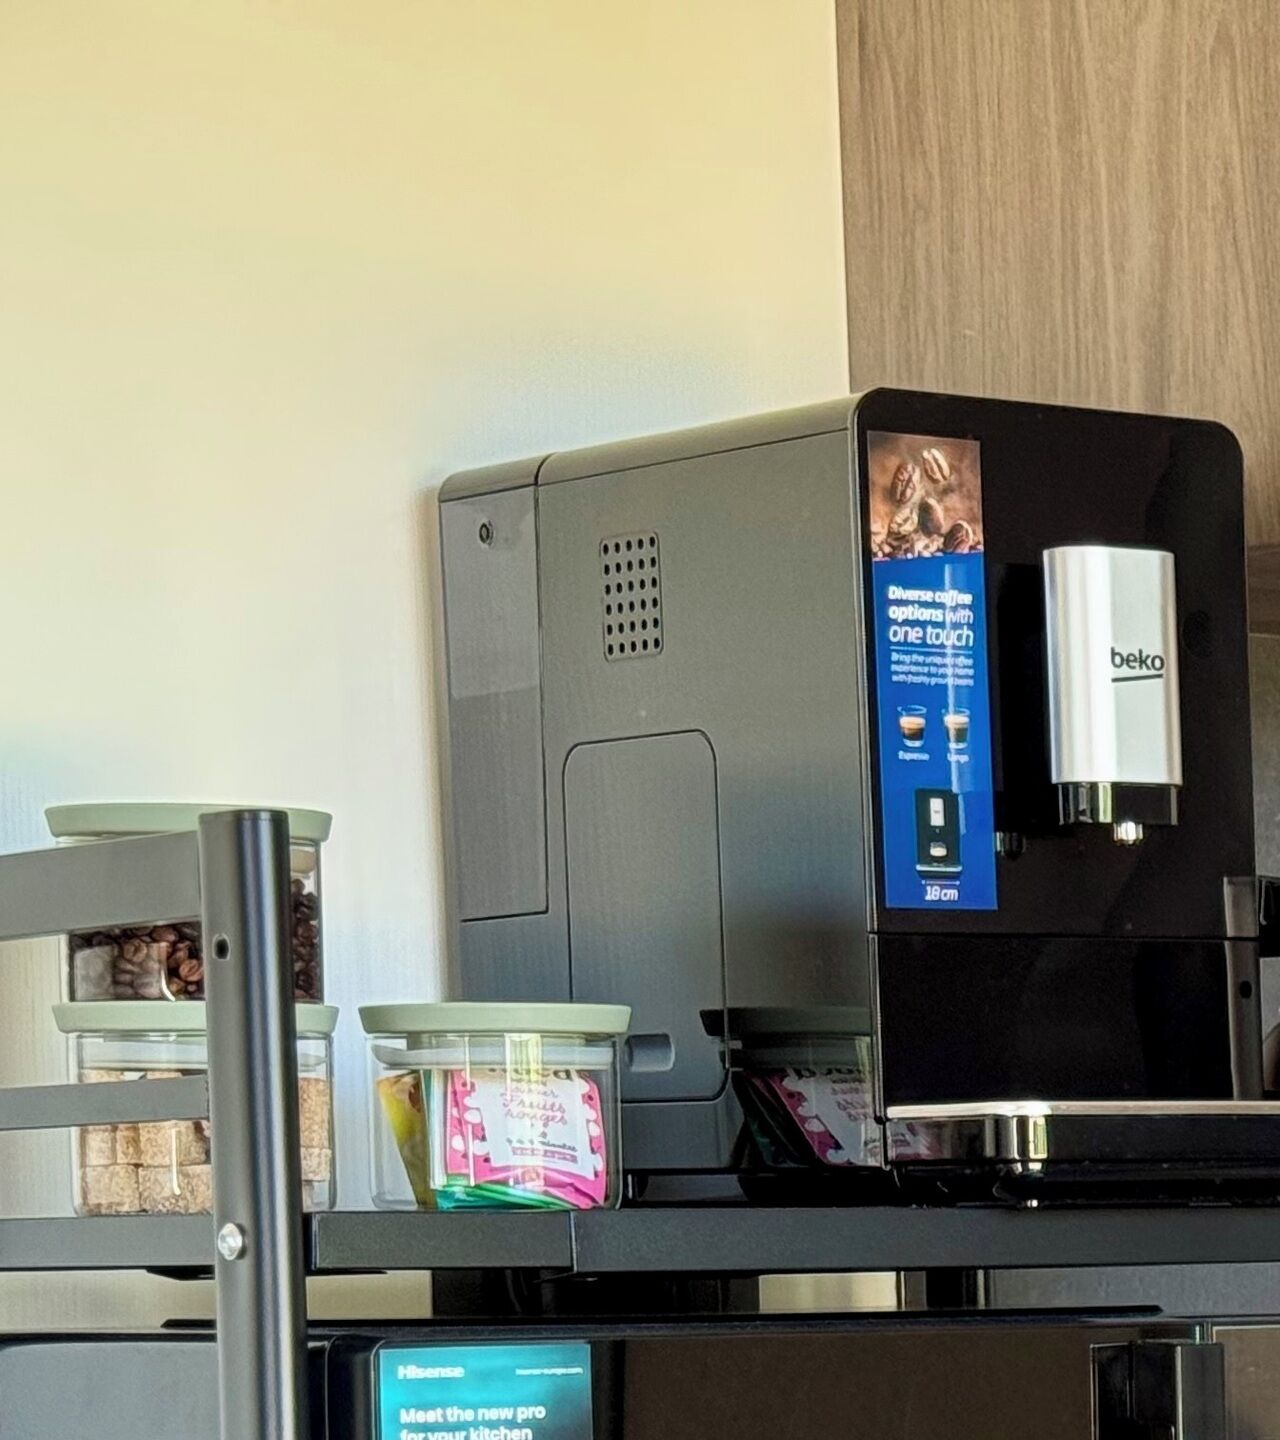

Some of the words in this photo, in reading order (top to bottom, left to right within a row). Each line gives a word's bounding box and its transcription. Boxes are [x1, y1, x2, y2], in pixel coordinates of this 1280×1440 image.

[888, 585, 933, 602] Diverse
[934, 590, 973, 606] coffee
[888, 604, 944, 623] options
[945, 608, 974, 624] with
[889, 625, 923, 644] one
[926, 625, 974, 647] touch
[1110, 646, 1165, 671] beko
[397, 1364, 465, 1380] Hisense
[400, 1407, 444, 1424] Meet
[446, 1406, 475, 1422] the
[477, 1406, 514, 1421] new
[516, 1405, 546, 1423] pro
